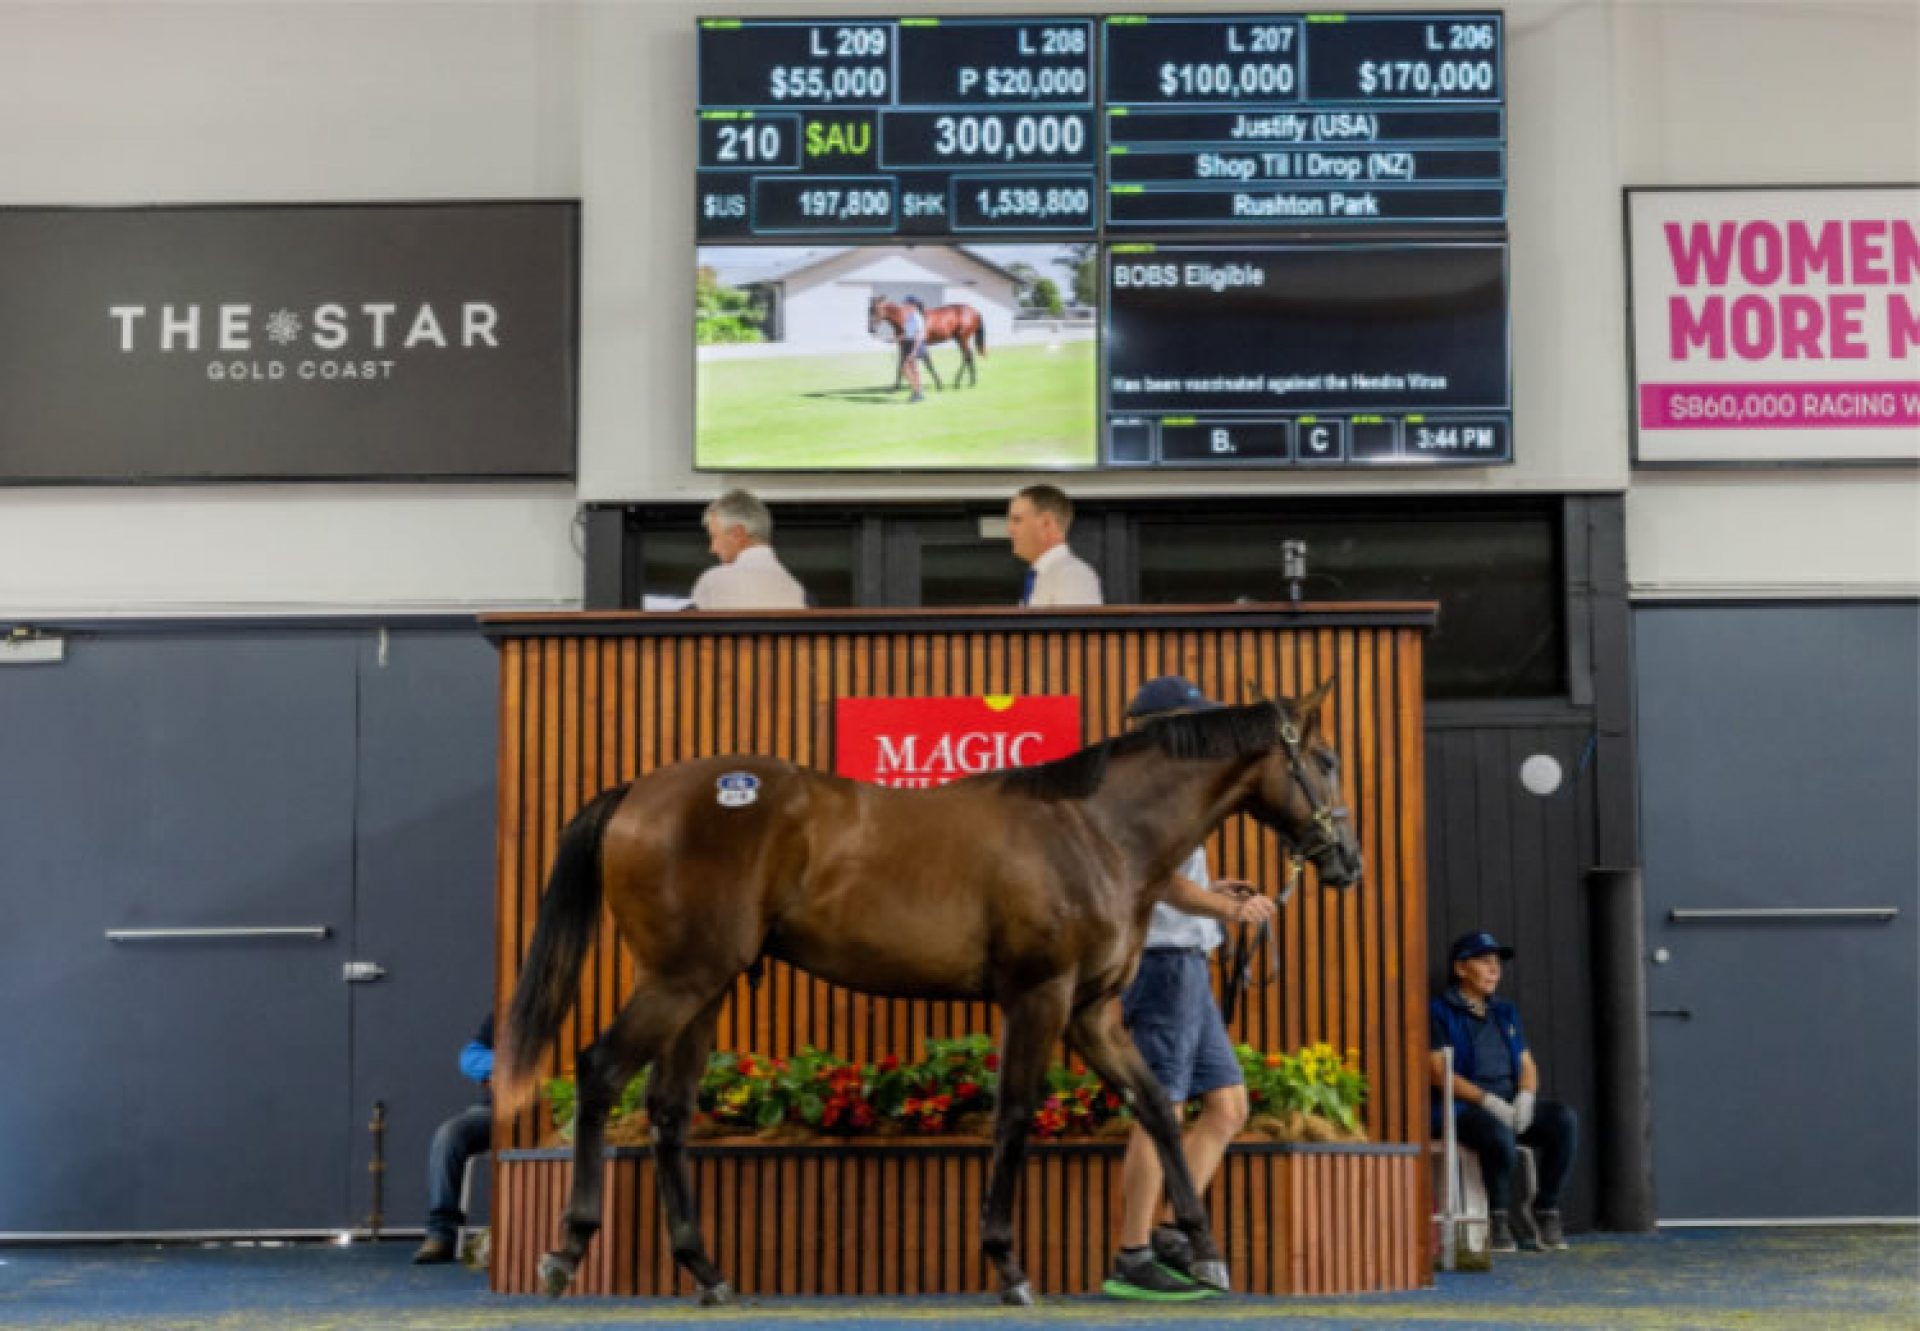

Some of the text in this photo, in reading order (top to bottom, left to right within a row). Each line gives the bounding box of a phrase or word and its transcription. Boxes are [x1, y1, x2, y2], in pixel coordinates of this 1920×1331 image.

[810, 28, 886, 55] L 209
[1018, 29, 1085, 54] L 208
[1228, 27, 1294, 52] L 207
[1427, 25, 1493, 50] L 206
[770, 67, 886, 101] $55,000
[959, 67, 1085, 99] P $20,000
[1160, 63, 1293, 97] $100,000
[1359, 61, 1492, 96] $170,000
[806, 121, 870, 156] $AU
[935, 116, 1084, 161] 300,000
[1231, 114, 1378, 141] Justify (USA)
[717, 125, 781, 161] 210
[1197, 153, 1415, 181] Shop Till I Drop (NZ)
[704, 193, 746, 218] $US
[800, 190, 889, 219] 197,800
[903, 192, 945, 216] $HK
[977, 189, 1089, 218] 1,539,800
[1233, 193, 1379, 216] Rushton Park
[1114, 264, 1264, 292] BOBS Eligible
[109, 302, 500, 352] THE STAR
[1669, 294, 1869, 361] MORE
[206, 360, 396, 380] GOLD COAST
[1804, 393, 1896, 418] RACING
[1311, 429, 1329, 452] C
[1417, 428, 1493, 449] 3:44 PM
[874, 732, 1044, 773] MAGIC
